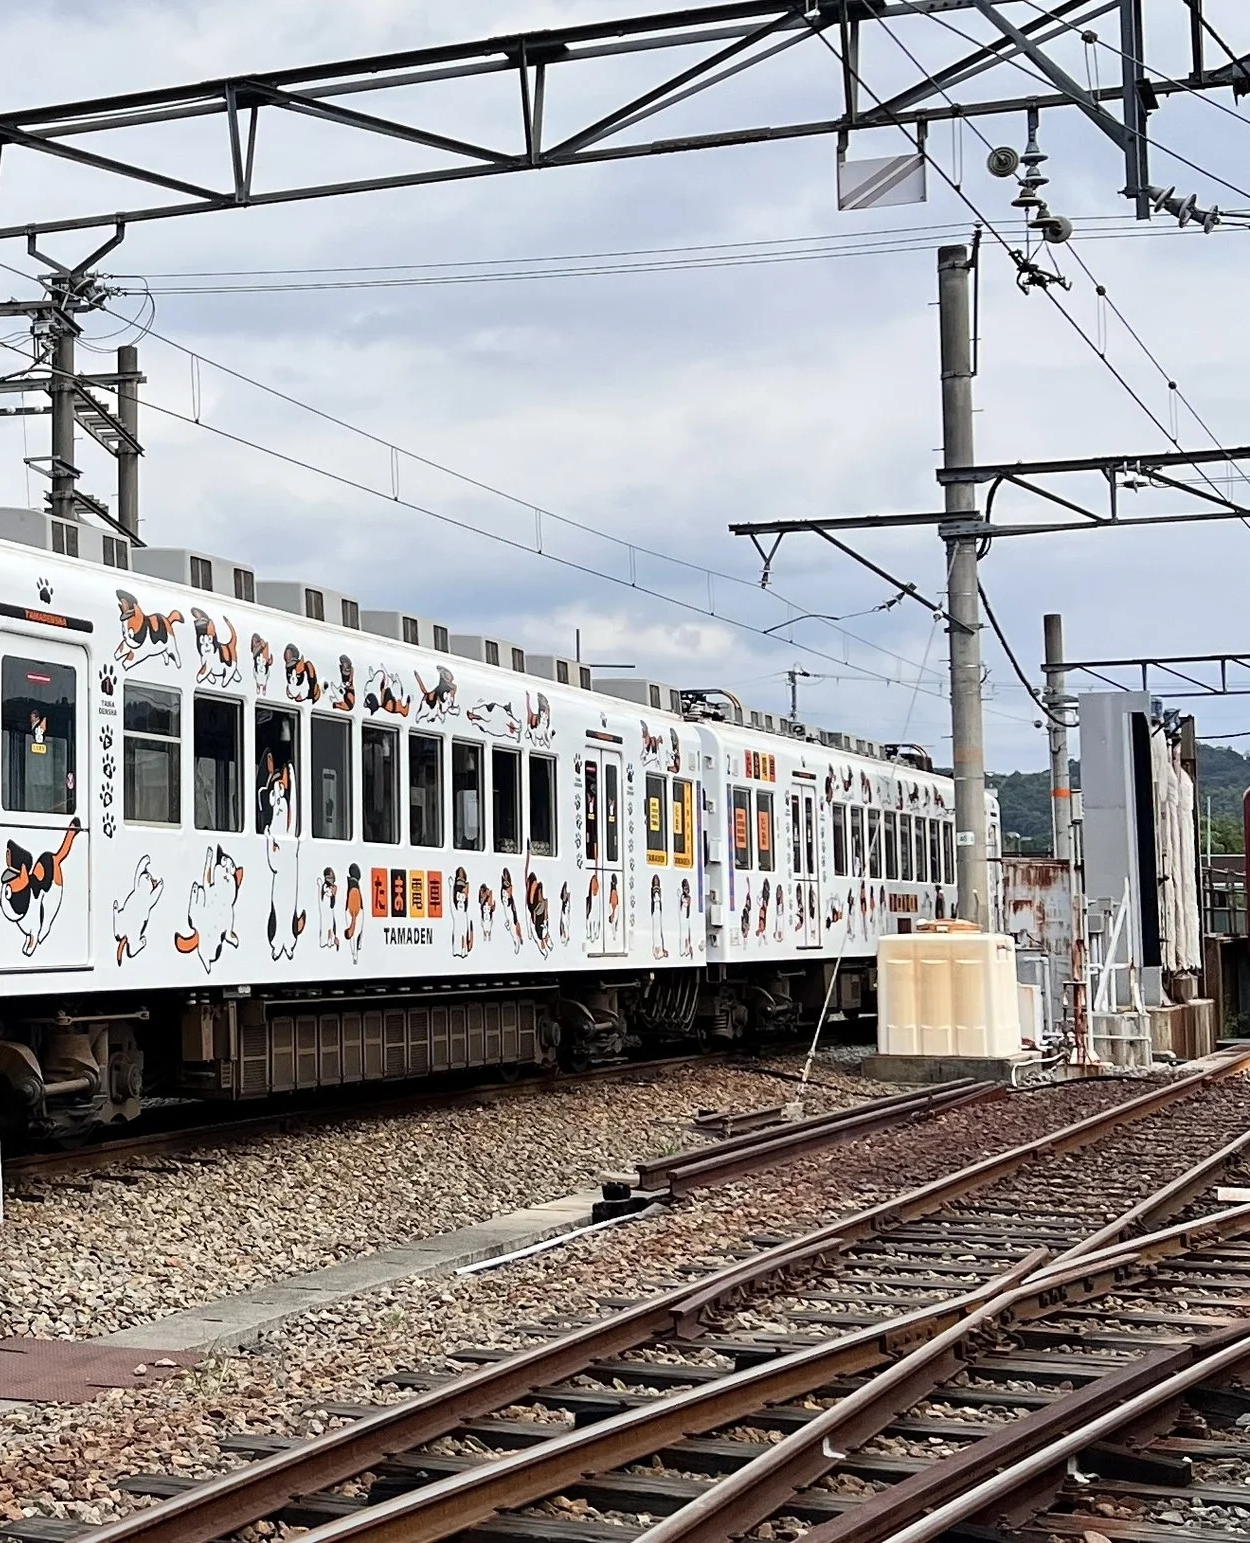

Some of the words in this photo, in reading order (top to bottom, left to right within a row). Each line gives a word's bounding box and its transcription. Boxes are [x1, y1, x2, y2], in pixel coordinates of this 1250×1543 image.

[373, 874, 441, 912] たま電車
[383, 927, 433, 945] TAMADEN
